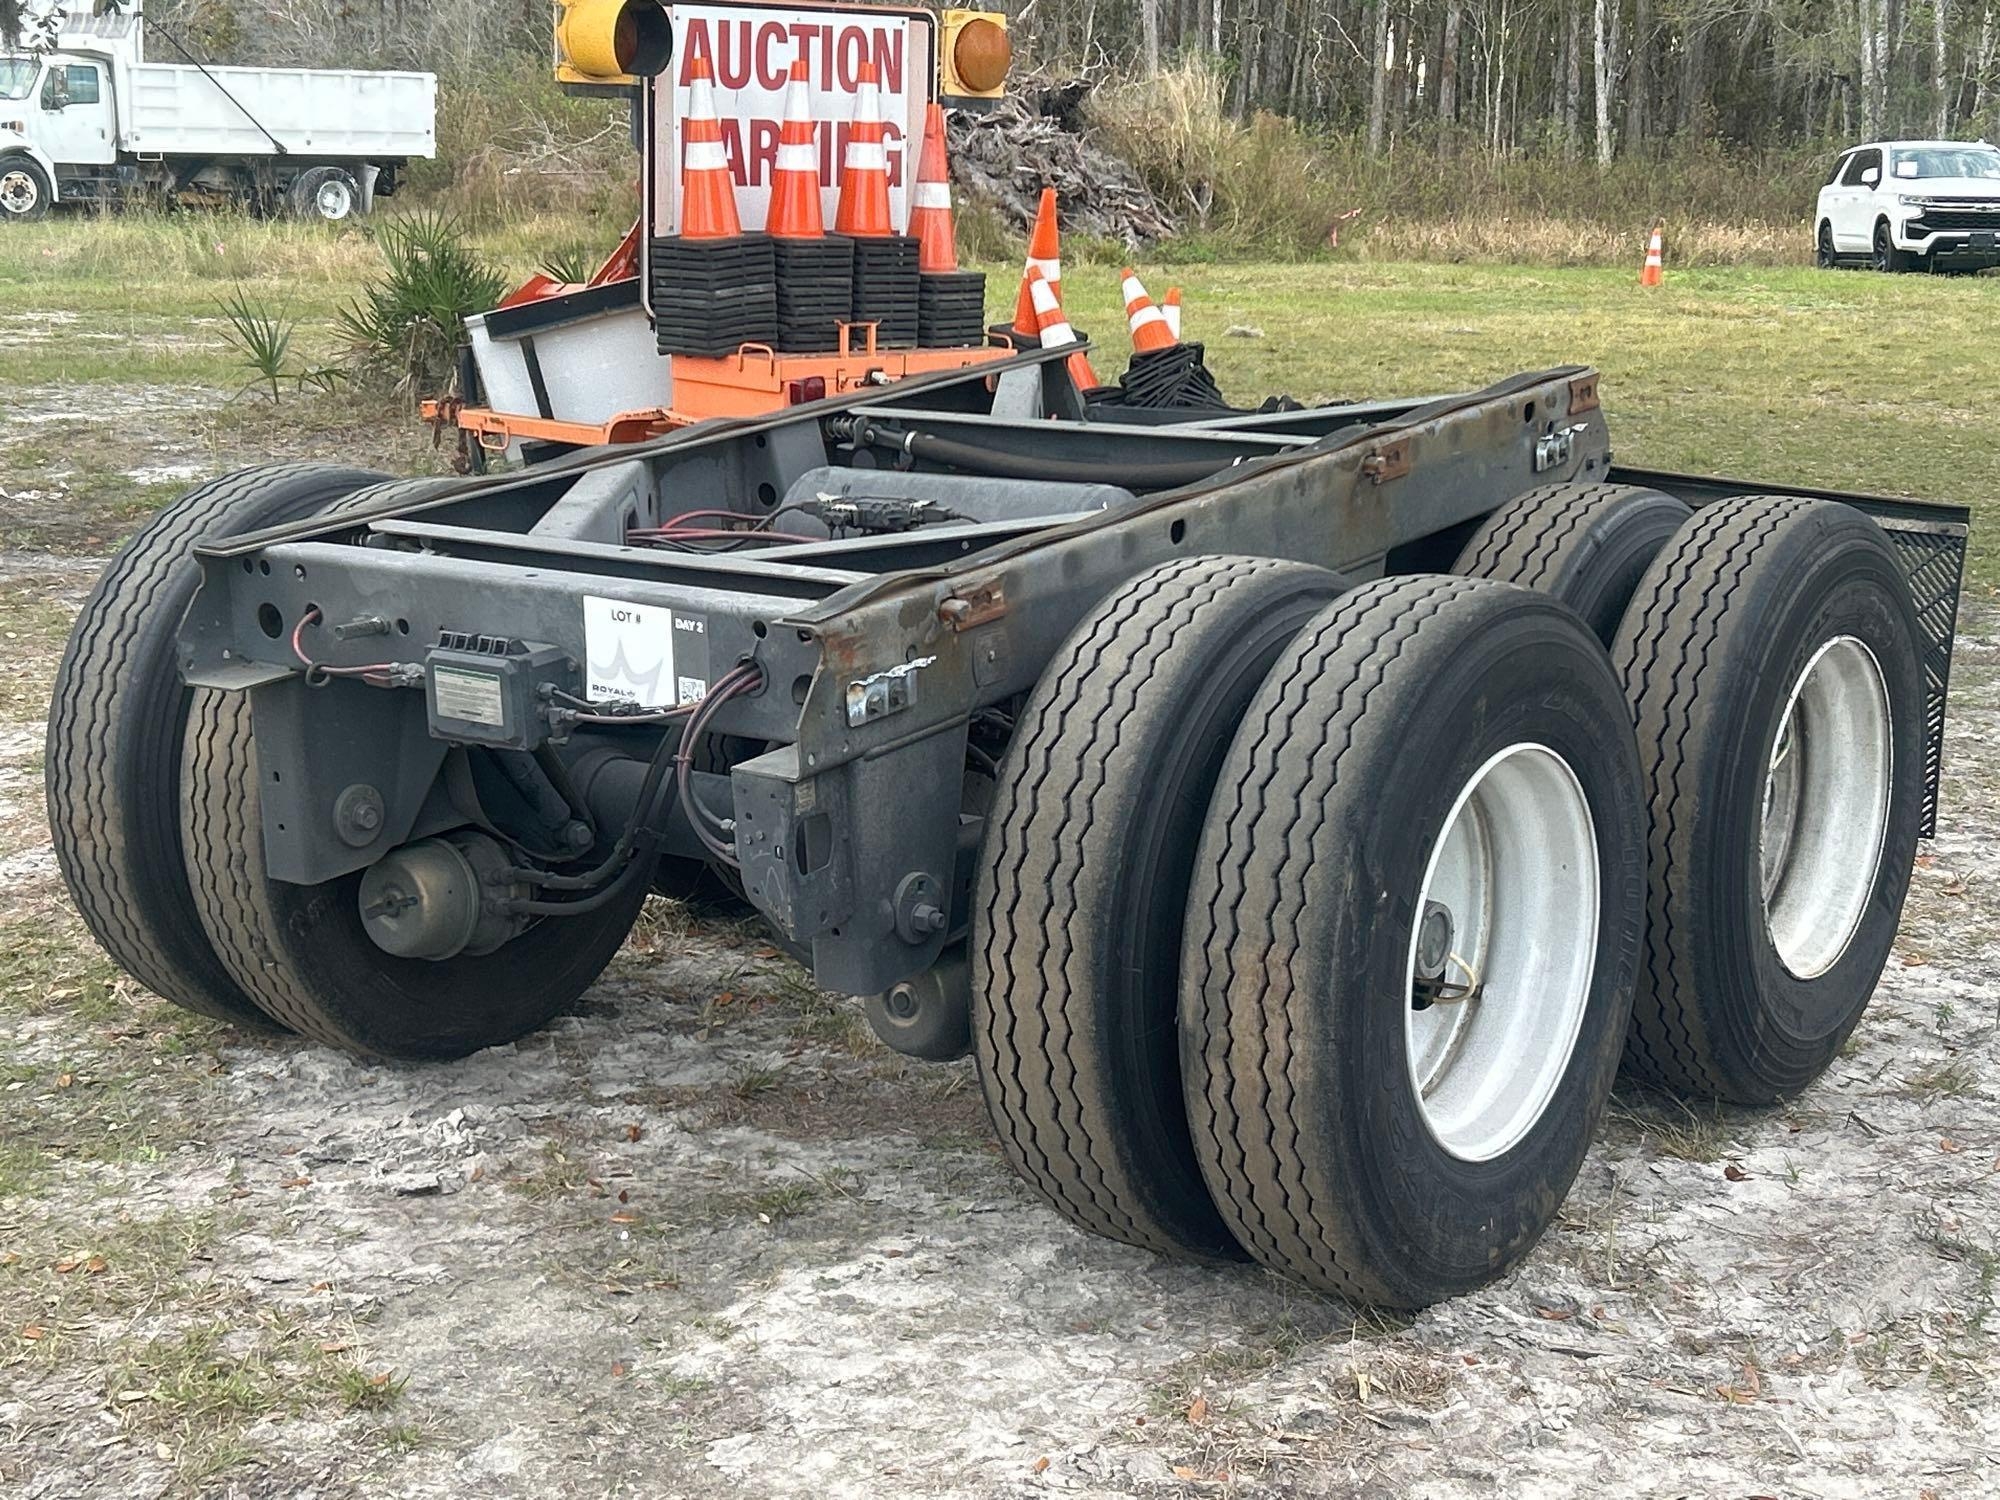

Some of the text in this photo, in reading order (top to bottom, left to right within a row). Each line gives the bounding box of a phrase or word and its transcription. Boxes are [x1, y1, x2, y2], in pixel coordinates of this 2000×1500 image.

[679, 18, 903, 94] AUCTION
[681, 117, 902, 187] ARIG
[611, 609, 632, 622] LOT
[675, 618, 704, 634] DAY 2
[592, 684, 627, 697] ROYAL
